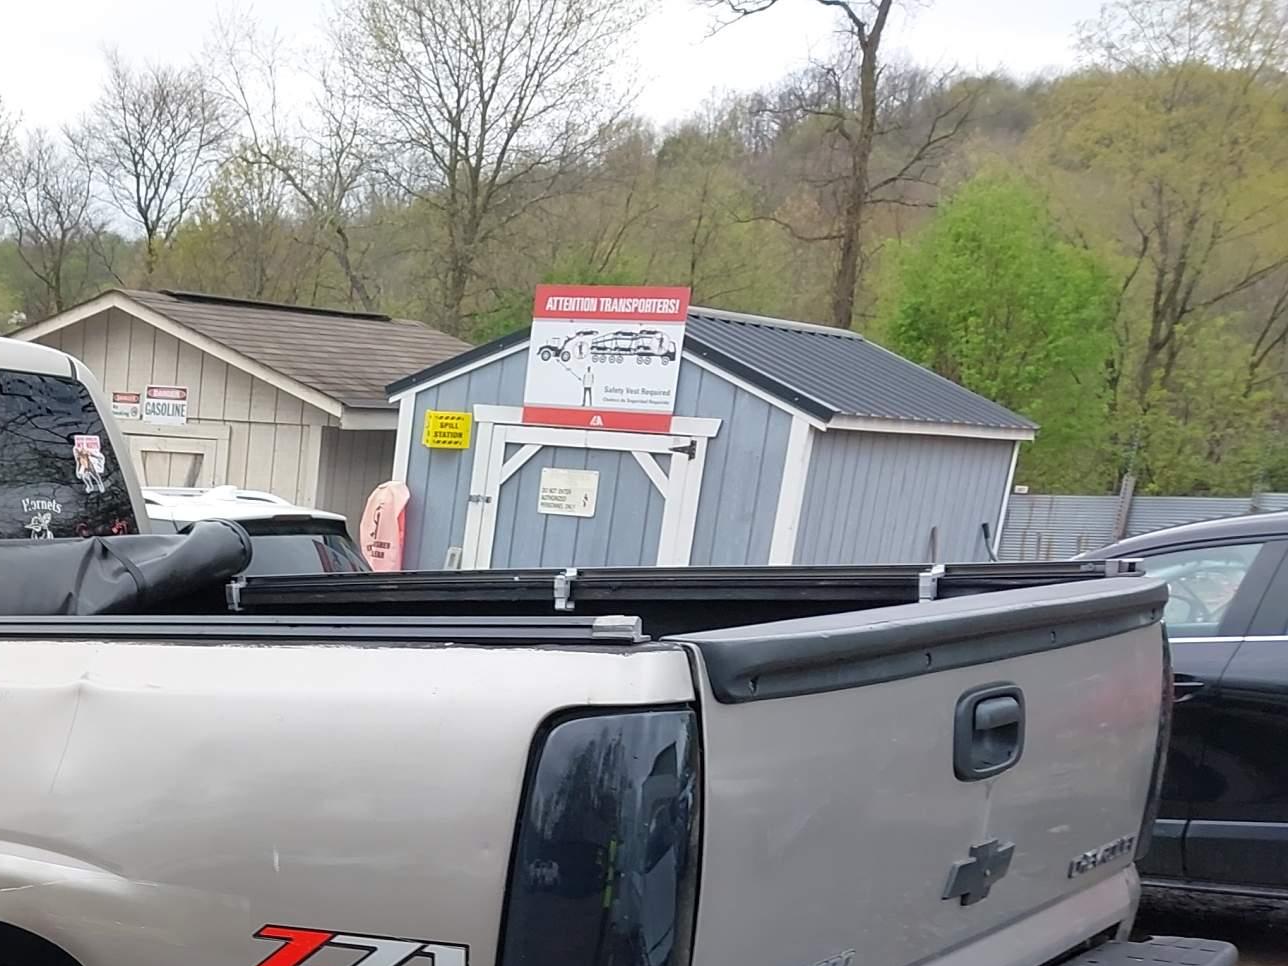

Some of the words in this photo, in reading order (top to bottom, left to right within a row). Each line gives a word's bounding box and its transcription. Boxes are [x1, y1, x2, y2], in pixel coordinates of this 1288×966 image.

[546, 296, 597, 312] ATTENTION
[599, 297, 680, 314] TRANSPORTERS!
[604, 385, 625, 395] Safety
[626, 386, 640, 395] Vest
[641, 388, 671, 397] Required
[145, 401, 186, 417] GASOLINE
[21, 498, 63, 514] Hornets
